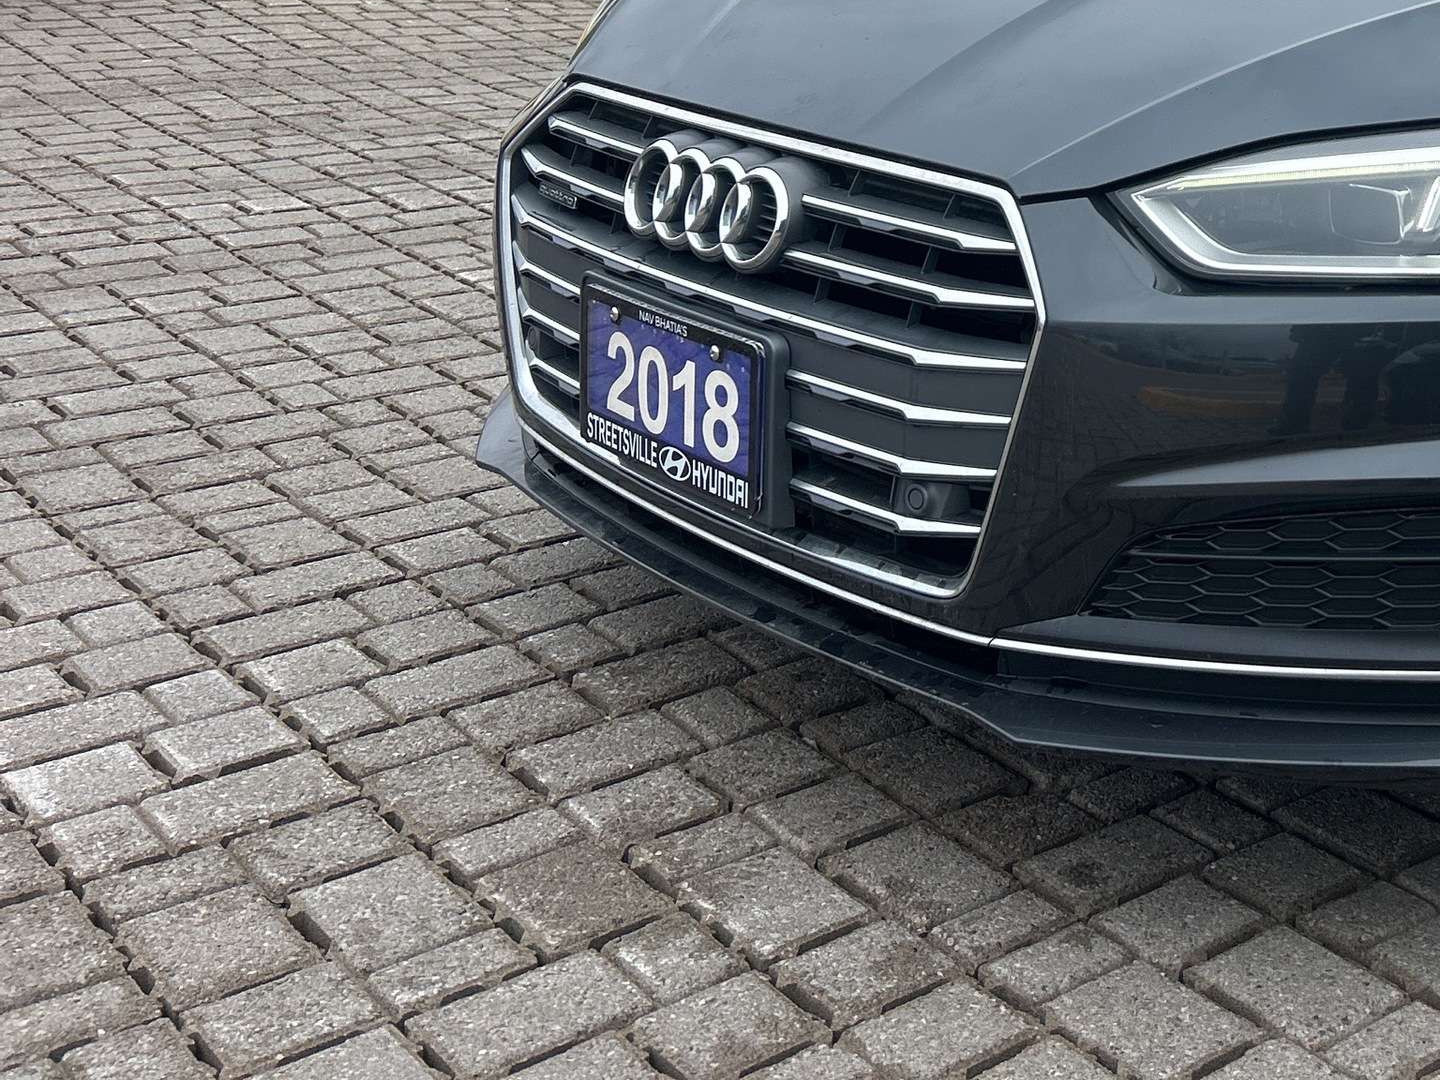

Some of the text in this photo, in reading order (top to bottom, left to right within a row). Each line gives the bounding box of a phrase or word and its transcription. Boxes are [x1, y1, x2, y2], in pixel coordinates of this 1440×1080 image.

[638, 309, 688, 338] NAV BHATIA'S
[606, 331, 740, 463] 2018
[586, 411, 749, 509] STREETSVILLE HYUNDAI
